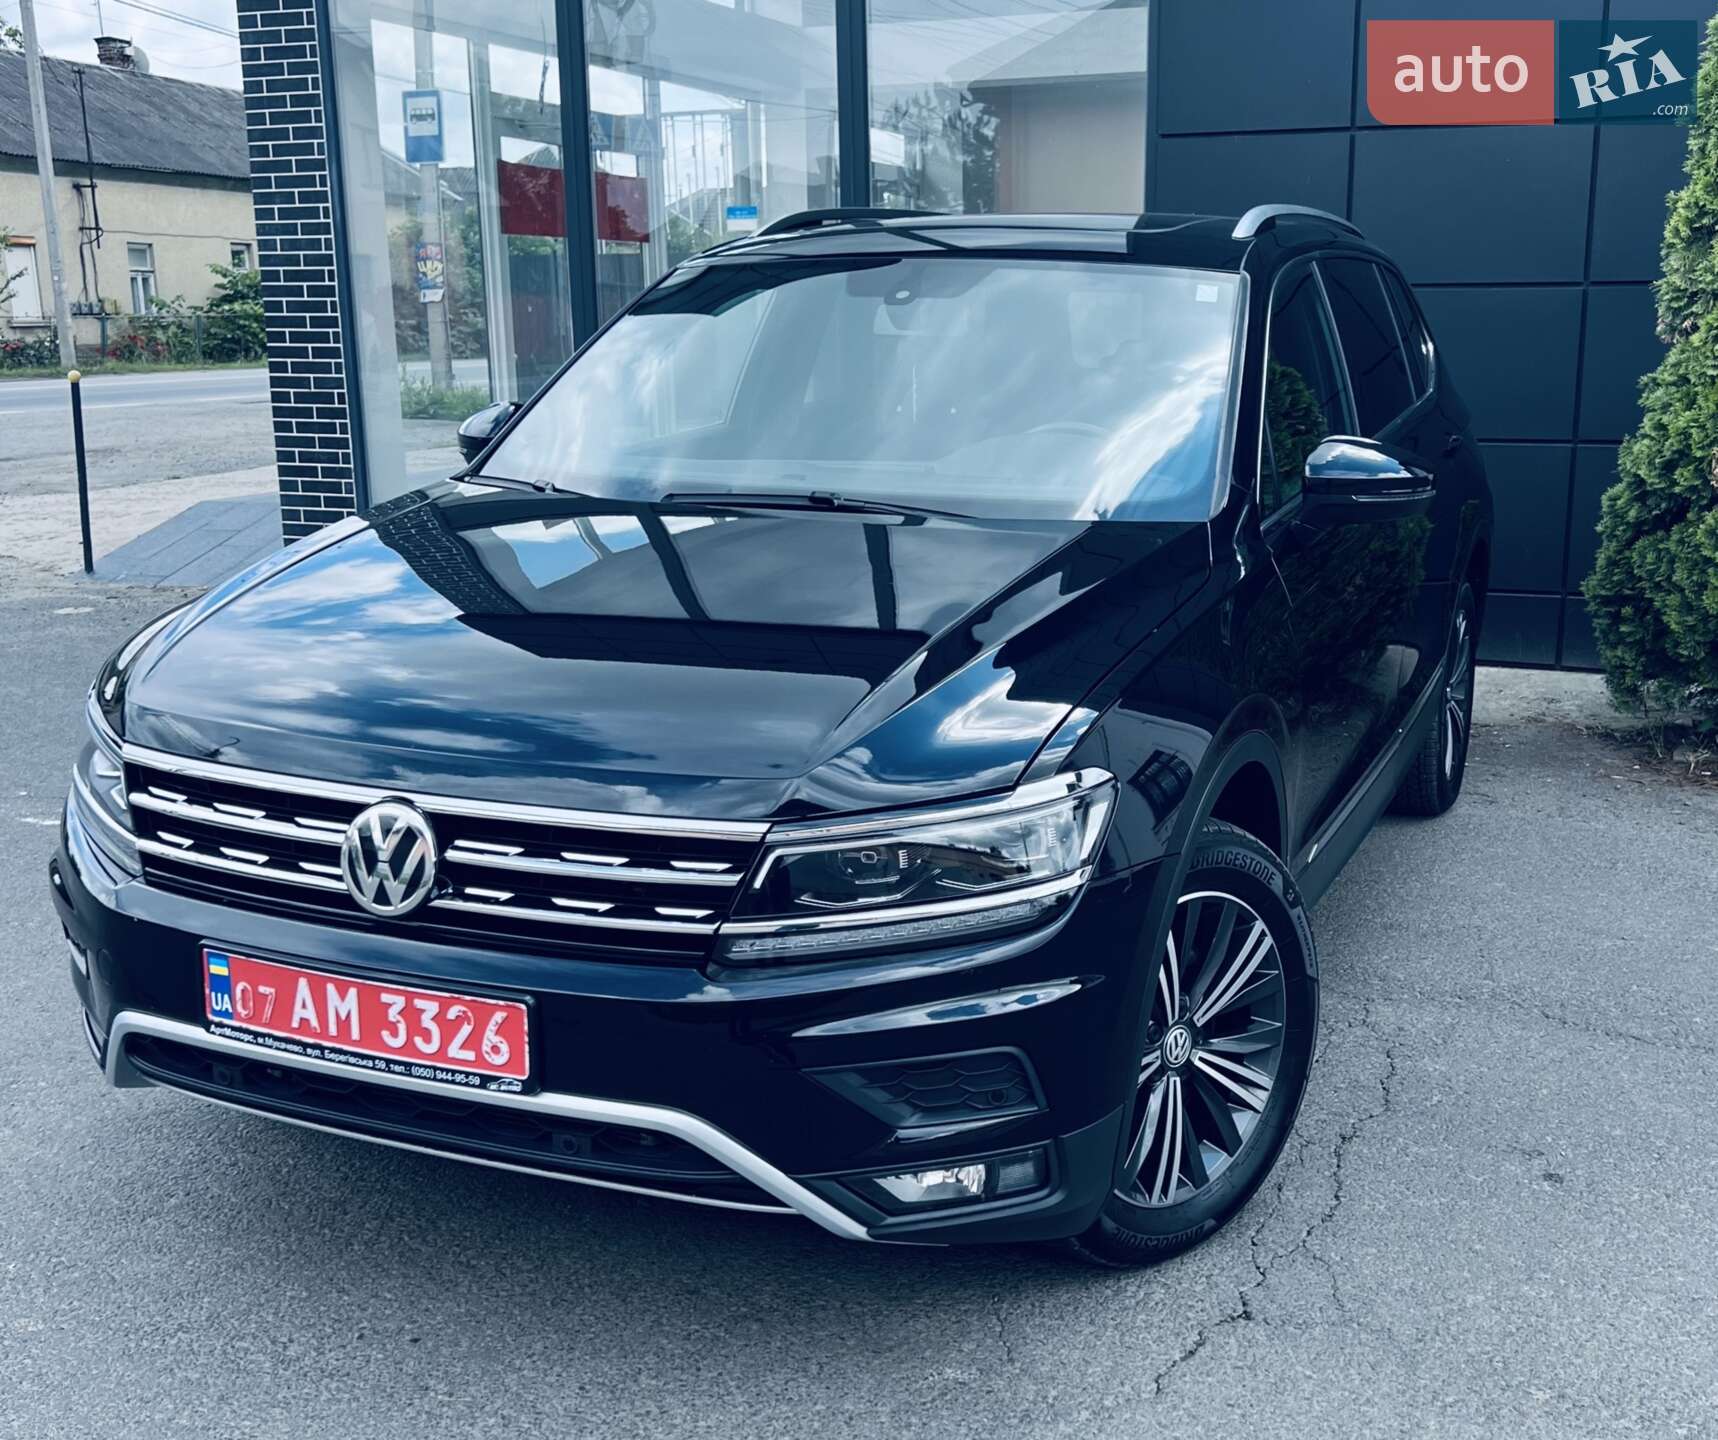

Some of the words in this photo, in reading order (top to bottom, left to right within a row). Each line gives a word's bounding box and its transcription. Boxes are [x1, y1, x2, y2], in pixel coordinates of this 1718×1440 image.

[1191, 850, 1276, 886] BRIDGESTONE
[211, 991, 233, 1013] UA
[235, 981, 276, 1024] 07
[290, 976, 361, 1041] AM
[379, 993, 511, 1067] 3326
[411, 1065, 434, 1079] (050)
[435, 1070, 480, 1086] 944-95-59
